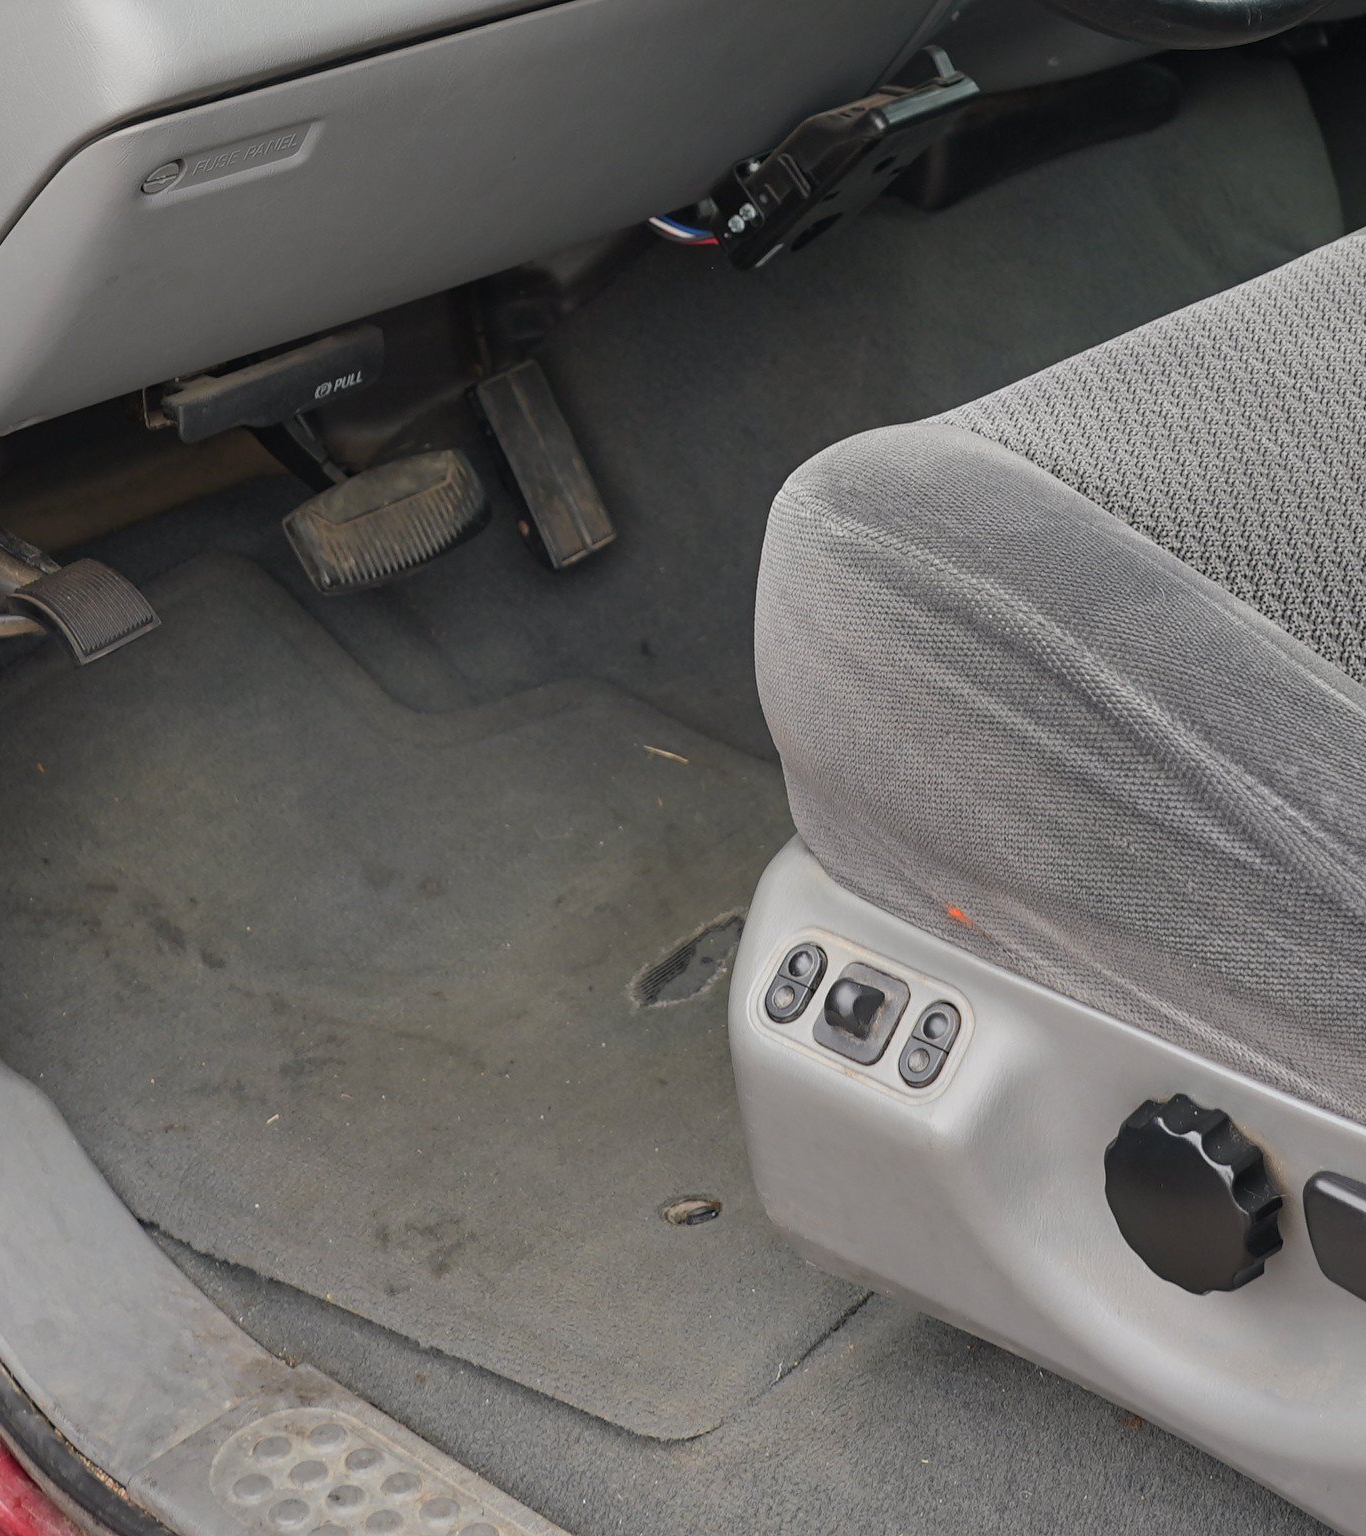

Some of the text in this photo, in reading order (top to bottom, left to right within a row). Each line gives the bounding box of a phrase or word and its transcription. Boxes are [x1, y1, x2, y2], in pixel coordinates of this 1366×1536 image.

[192, 133, 297, 176] FUSE PANEL
[333, 370, 363, 392] PULL
